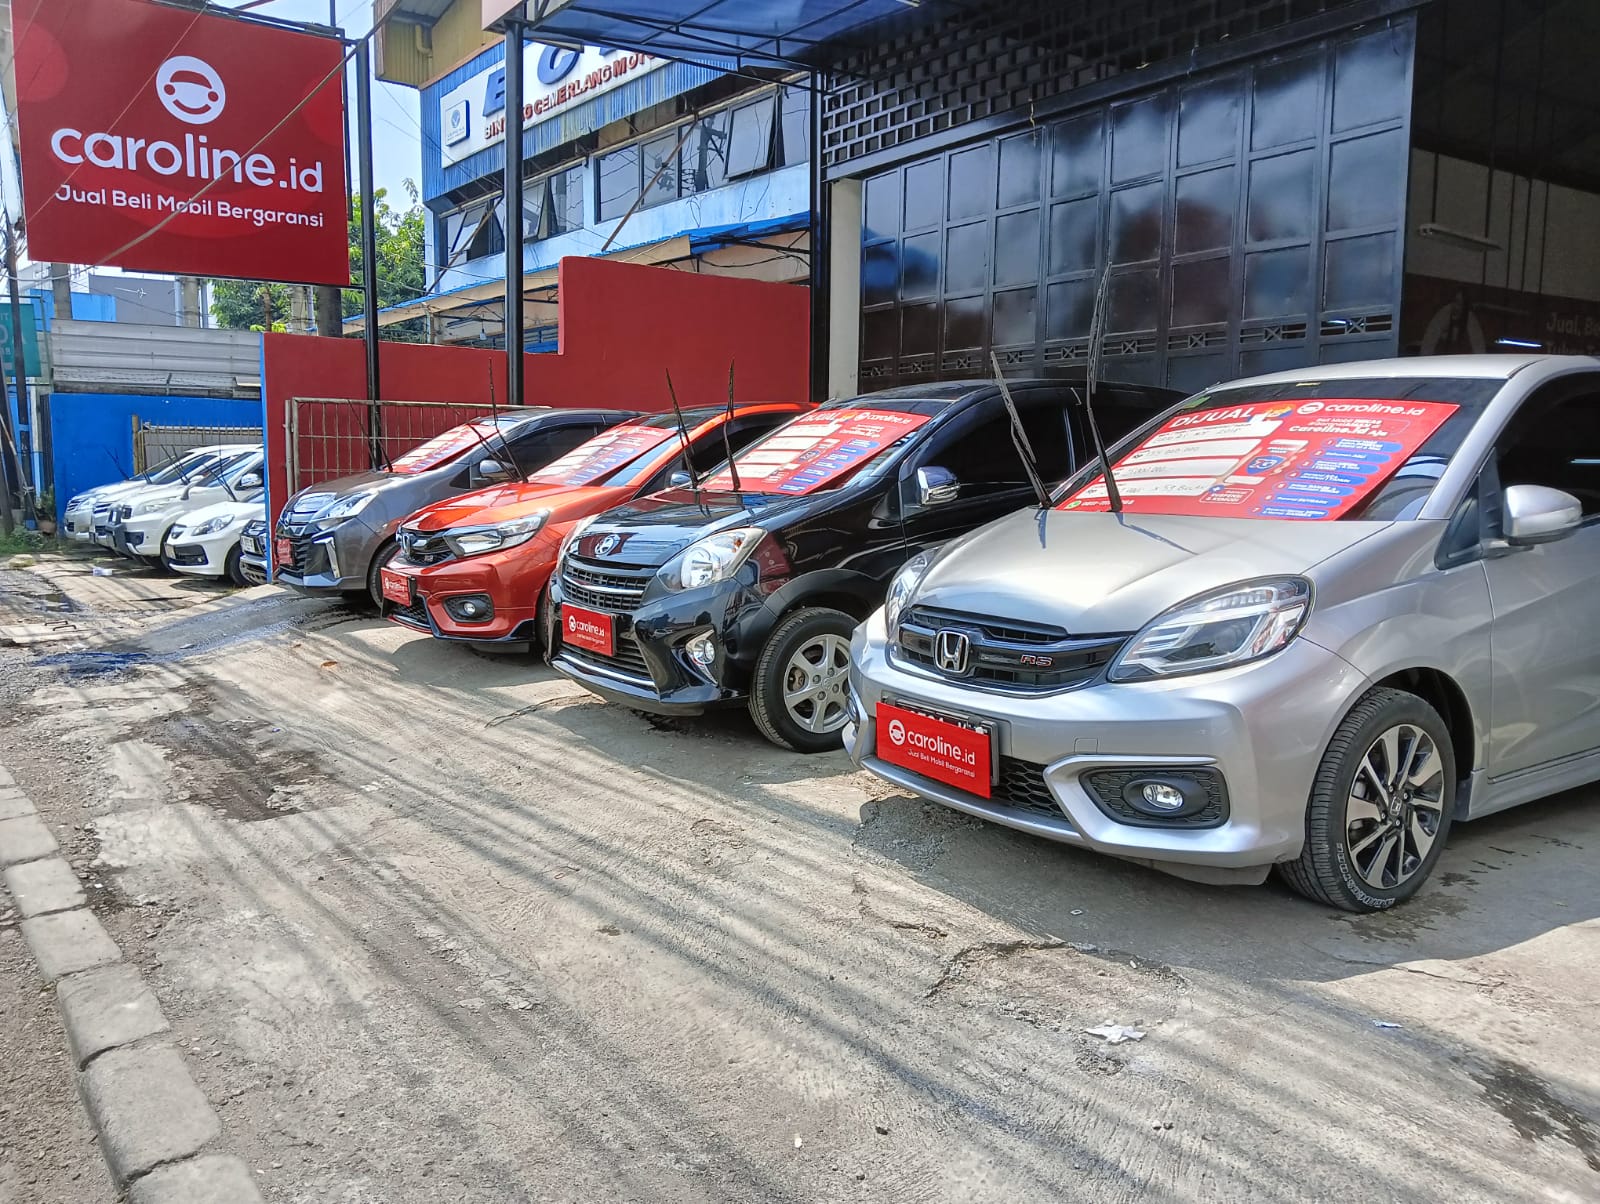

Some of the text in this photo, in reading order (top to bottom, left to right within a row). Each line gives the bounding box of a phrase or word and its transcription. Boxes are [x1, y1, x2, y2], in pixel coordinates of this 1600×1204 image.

[51, 127, 323, 193] caroline.id
[55, 184, 324, 228] Jual Beli Mobil Bergaransi
[1168, 406, 1256, 428] DIJUAL
[1324, 402, 1426, 416] caroline.id
[1020, 654, 1053, 667] RS
[907, 730, 975, 766] caroline.id
